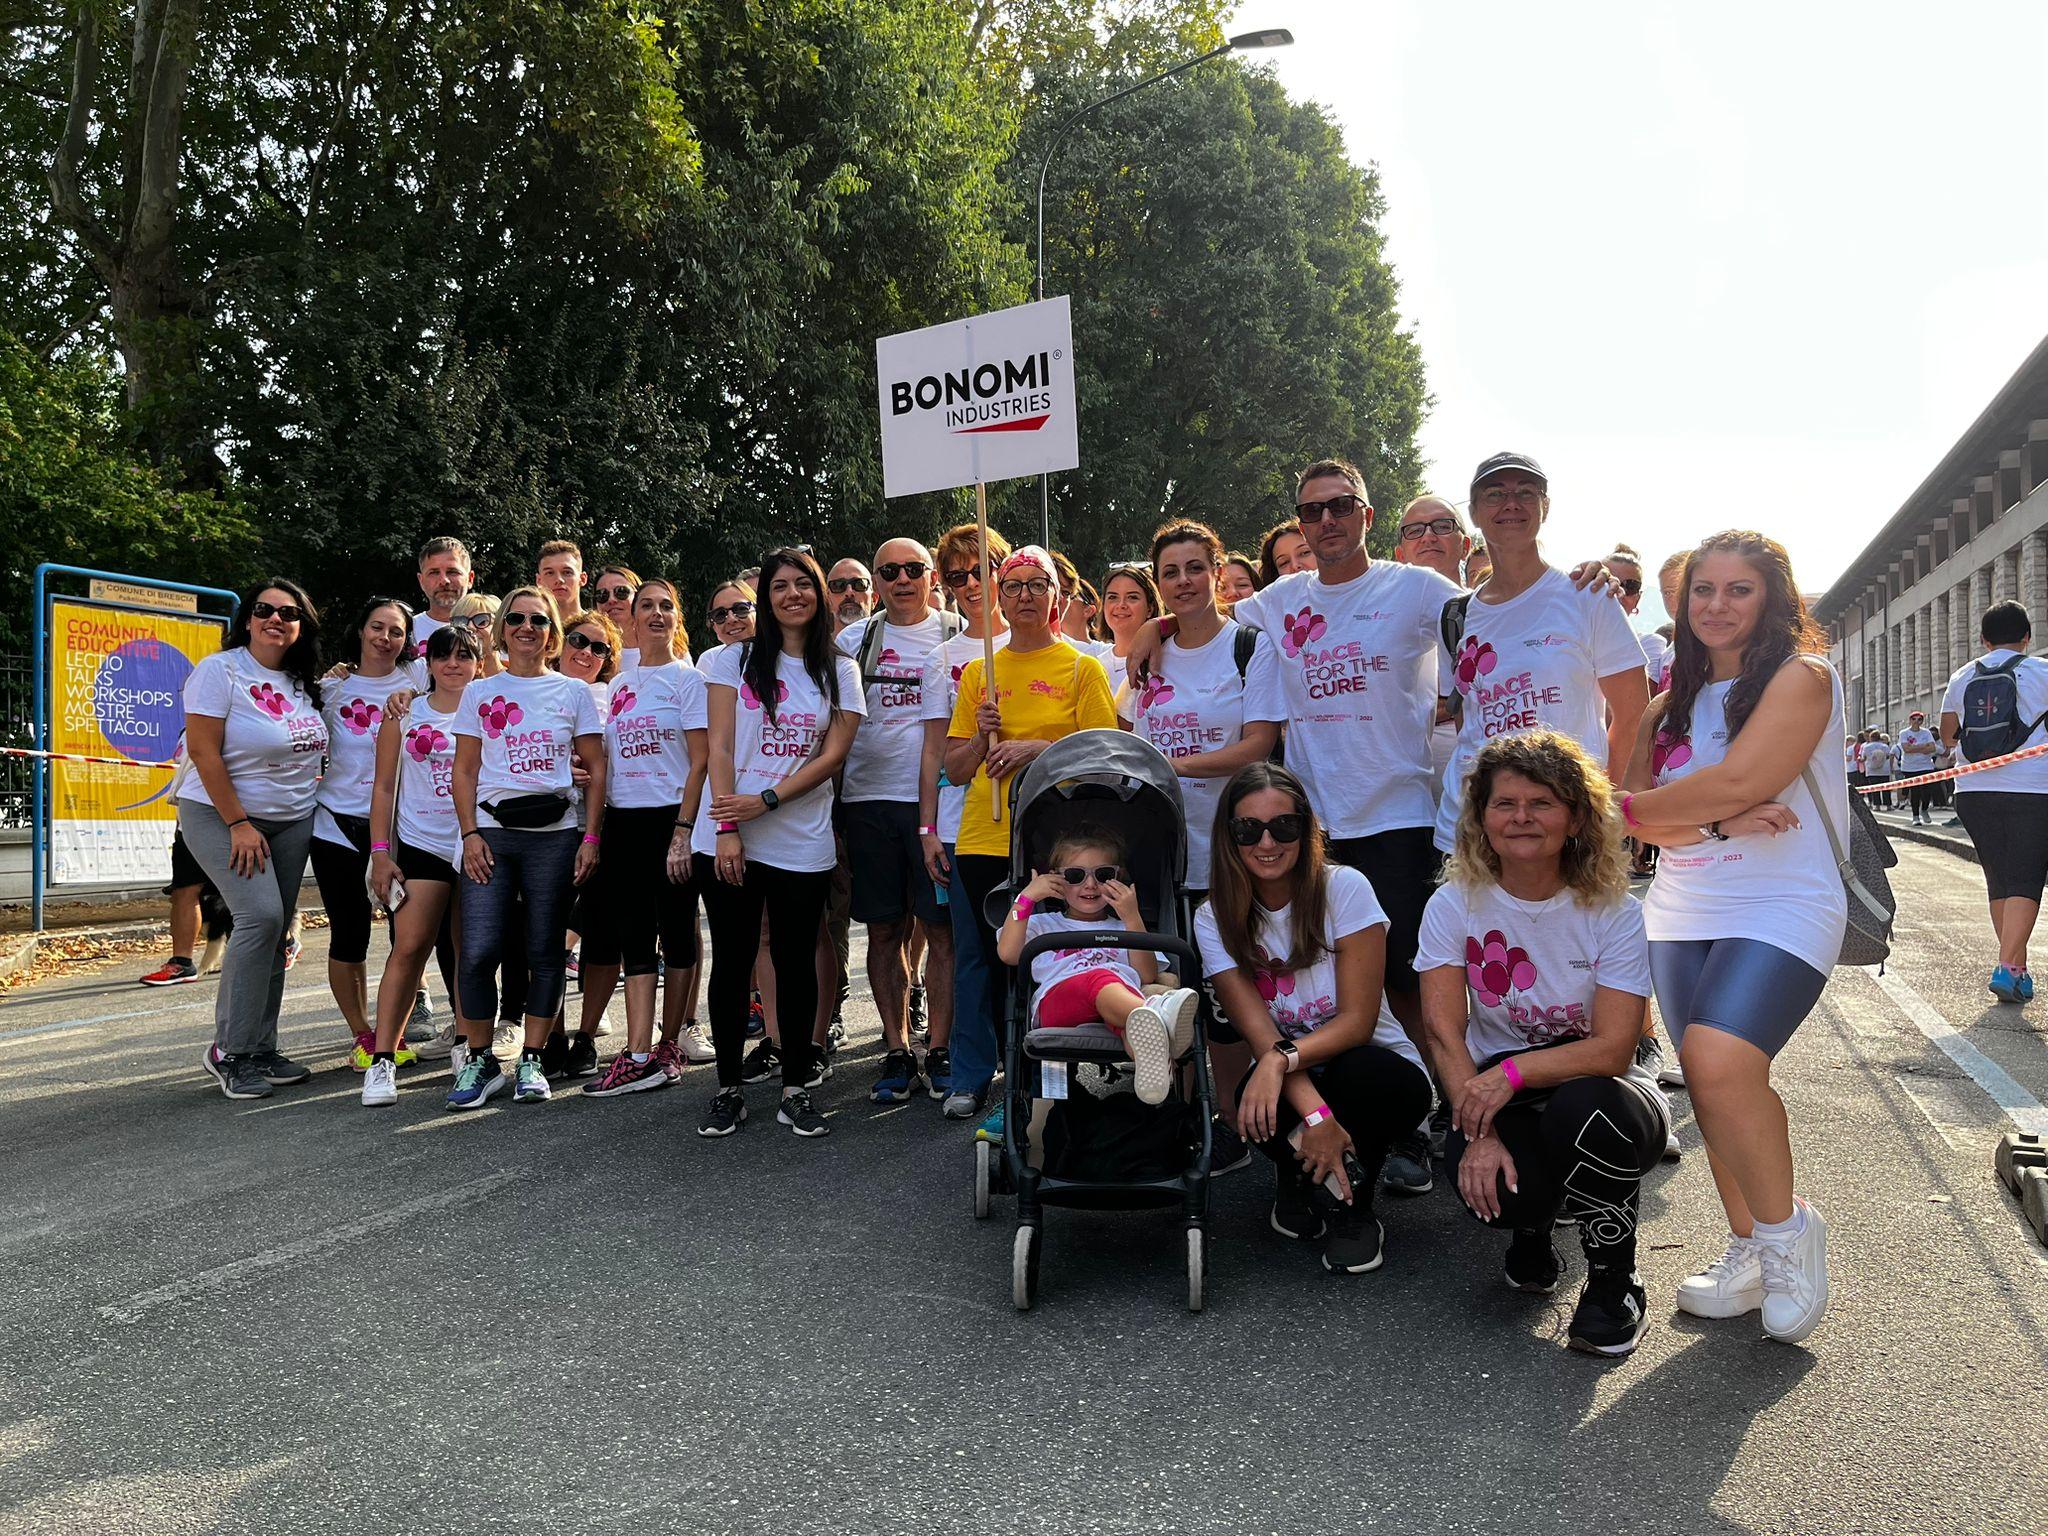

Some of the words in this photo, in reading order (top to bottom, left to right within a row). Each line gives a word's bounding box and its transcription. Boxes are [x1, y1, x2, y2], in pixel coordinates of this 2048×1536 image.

[891, 352, 1050, 416] BONOMI
[946, 392, 1051, 427] INDUSTRIES
[106, 584, 145, 596] COMUNE
[157, 591, 194, 603] BRESCIA
[67, 635, 160, 660] EDUCATIVE
[1303, 641, 1362, 669] RACE
[66, 651, 123, 671] LECTIO
[1306, 662, 1346, 685] FOR
[1349, 656, 1389, 674] THE
[66, 667, 114, 686] TALKS
[65, 683, 174, 707] WORKSHOPS
[1310, 675, 1367, 699] CURE
[1476, 672, 1533, 705] RACE
[65, 700, 136, 720] MOSTRE
[1482, 698, 1517, 723] FOR
[1520, 686, 1562, 709] THE
[64, 716, 160, 737] SPETTACOLI
[287, 716, 321, 731] RACE
[616, 716, 657, 733] RACE
[1148, 712, 1200, 732] RACE
[1484, 710, 1539, 739] CURE
[291, 729, 318, 742] FOR
[505, 730, 554, 748] RACE
[619, 730, 646, 747] FOR
[646, 729, 676, 741] THE
[762, 727, 798, 742] FOR
[1151, 730, 1185, 746] FOR
[1187, 727, 1224, 744] THE
[293, 739, 327, 753] CURE
[508, 745, 541, 762] FOR
[543, 744, 566, 757] THE
[621, 742, 662, 759] CURE
[761, 743, 812, 757] CURE
[510, 759, 555, 774] CURE
[433, 772, 453, 785] FO
[1723, 853, 1743, 862] 2023
[1278, 995, 1333, 1025] RACE
[1508, 1002, 1585, 1024] RACE
